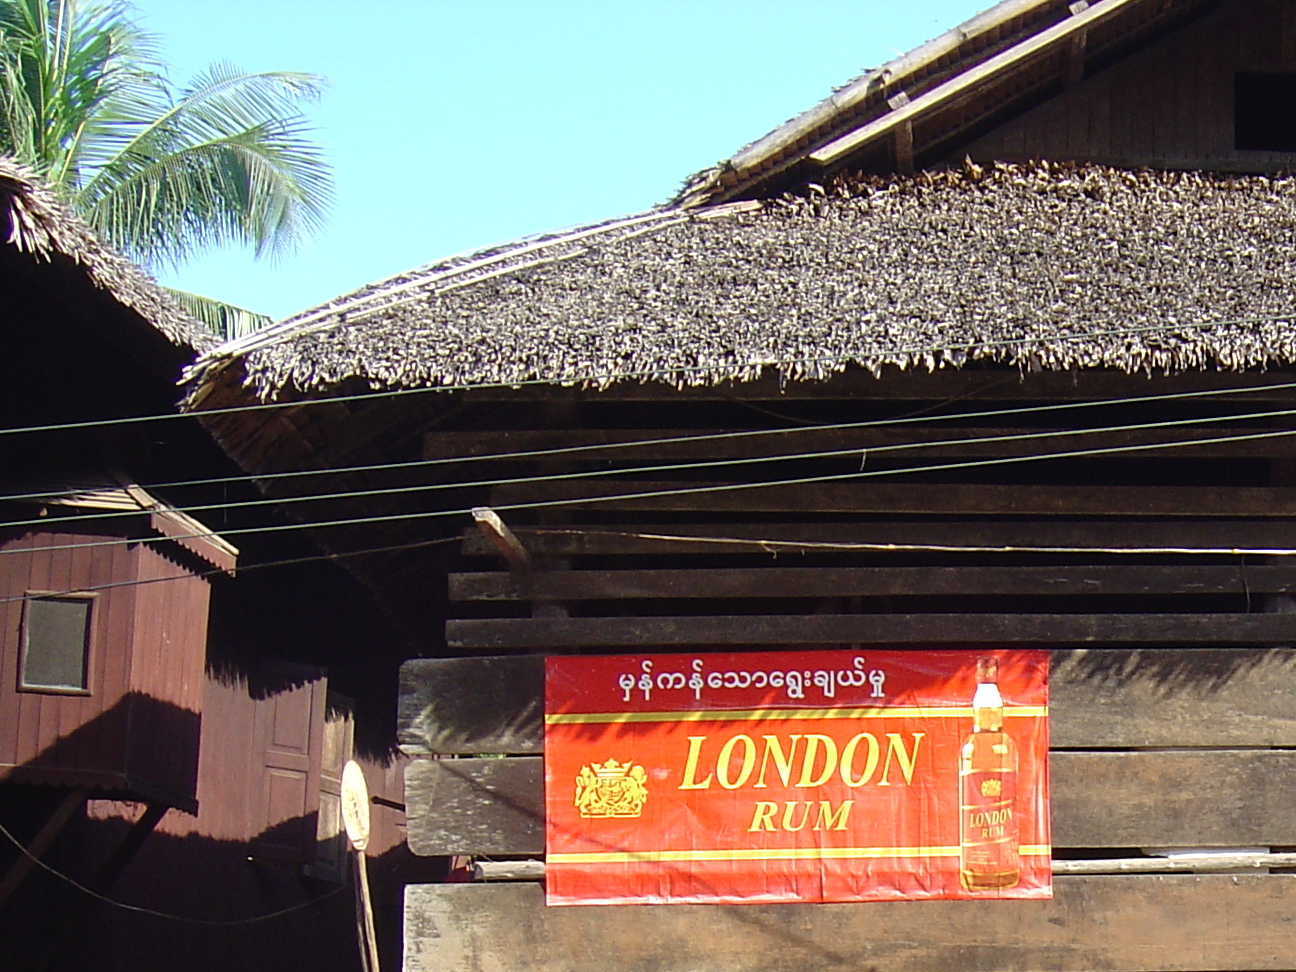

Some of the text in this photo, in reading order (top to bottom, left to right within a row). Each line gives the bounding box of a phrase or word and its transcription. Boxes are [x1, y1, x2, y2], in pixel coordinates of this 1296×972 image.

[618, 657, 886, 701] မှန်ကန်သောရွေးချယ်မှု
[678, 732, 925, 791] LONDON
[748, 800, 855, 832] RUM
[969, 808, 1013, 828] LONDON
[981, 825, 1005, 838] RUM
